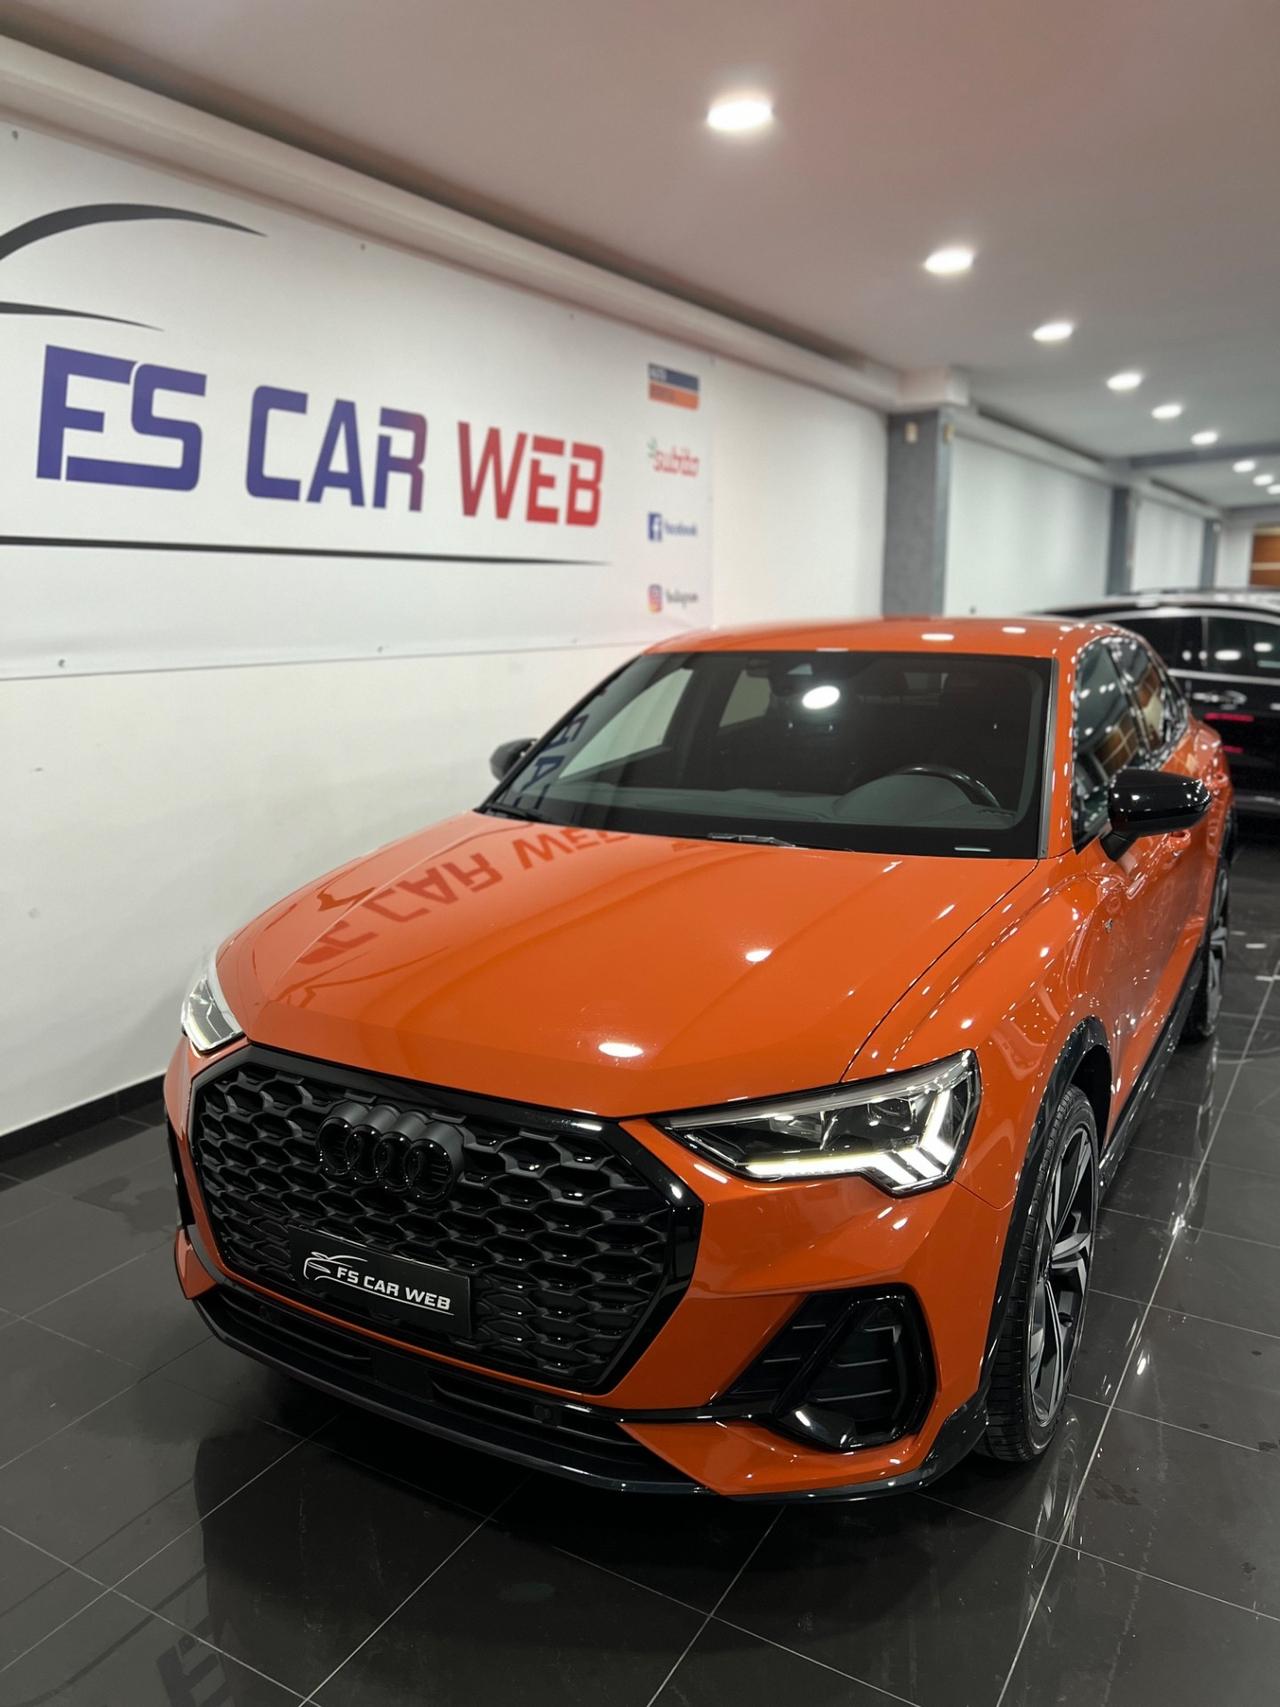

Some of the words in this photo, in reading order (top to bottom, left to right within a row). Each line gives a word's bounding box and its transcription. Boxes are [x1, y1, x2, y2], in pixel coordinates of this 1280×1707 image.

[37, 345, 206, 491] FS
[246, 386, 428, 512] CAR
[458, 422, 603, 527] WEB
[337, 1267, 359, 1284] FS
[363, 1276, 399, 1296] CAR
[405, 1287, 451, 1310] WEB
